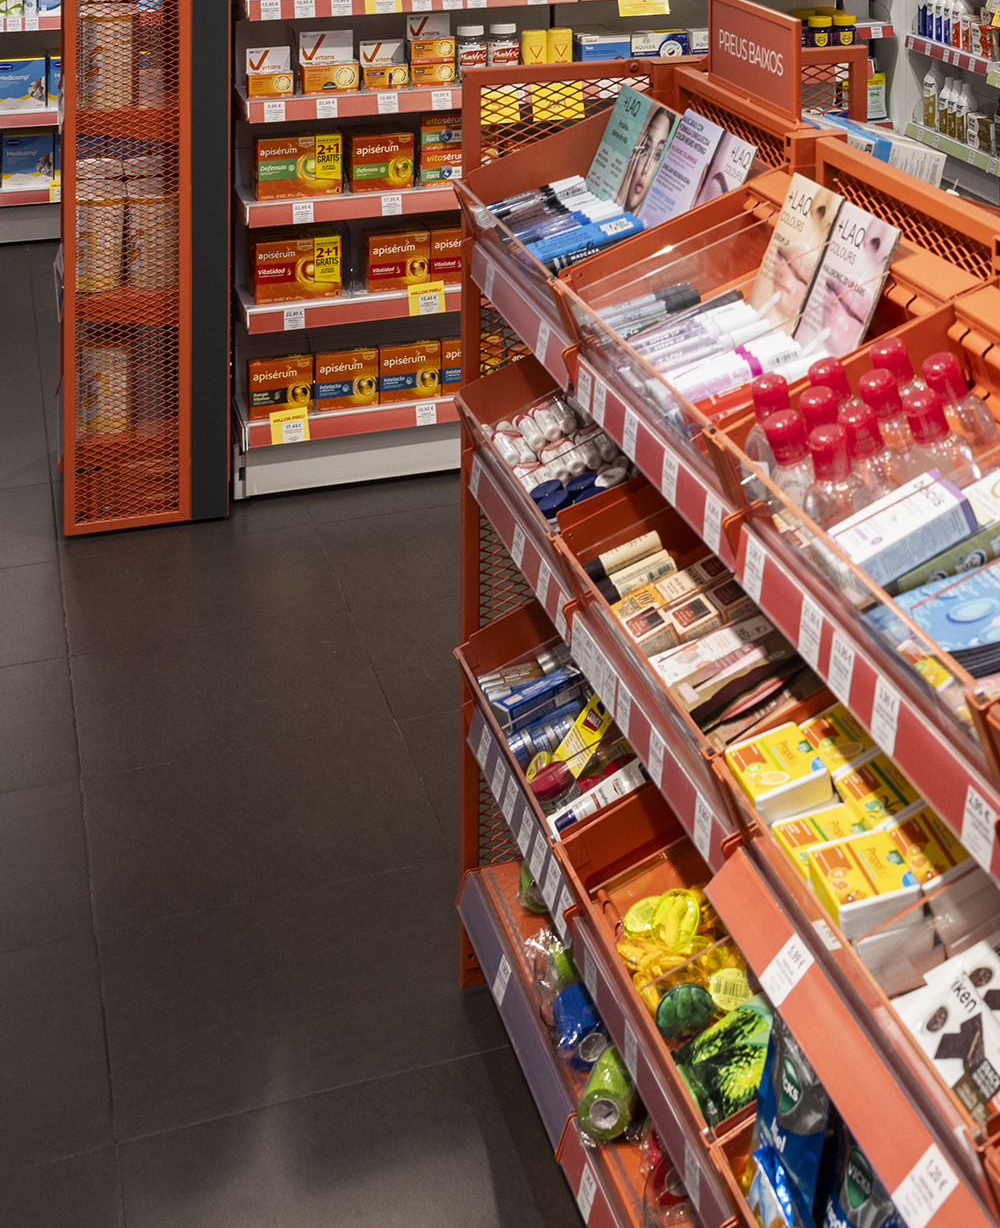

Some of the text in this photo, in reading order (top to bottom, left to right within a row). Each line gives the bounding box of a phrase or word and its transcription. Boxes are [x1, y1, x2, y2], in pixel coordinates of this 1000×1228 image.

[719, 29, 784, 77] PREUS BAIXOS
[260, 144, 298, 157] apisérum
[317, 143, 340, 156] 2+1
[356, 143, 399, 157] apisérum
[316, 154, 340, 164] GRATIS
[260, 164, 287, 173] Defensas
[356, 166, 379, 174] Defensas
[258, 249, 296, 261] apisérum
[316, 247, 338, 259] 2+1
[372, 242, 416, 257] apisérum
[315, 256, 339, 267] GRATIS
[257, 267, 286, 276] Vitalidad
[383, 353, 427, 368] apisérum
[319, 360, 363, 375] apisérum
[253, 368, 298, 383] apisérum
